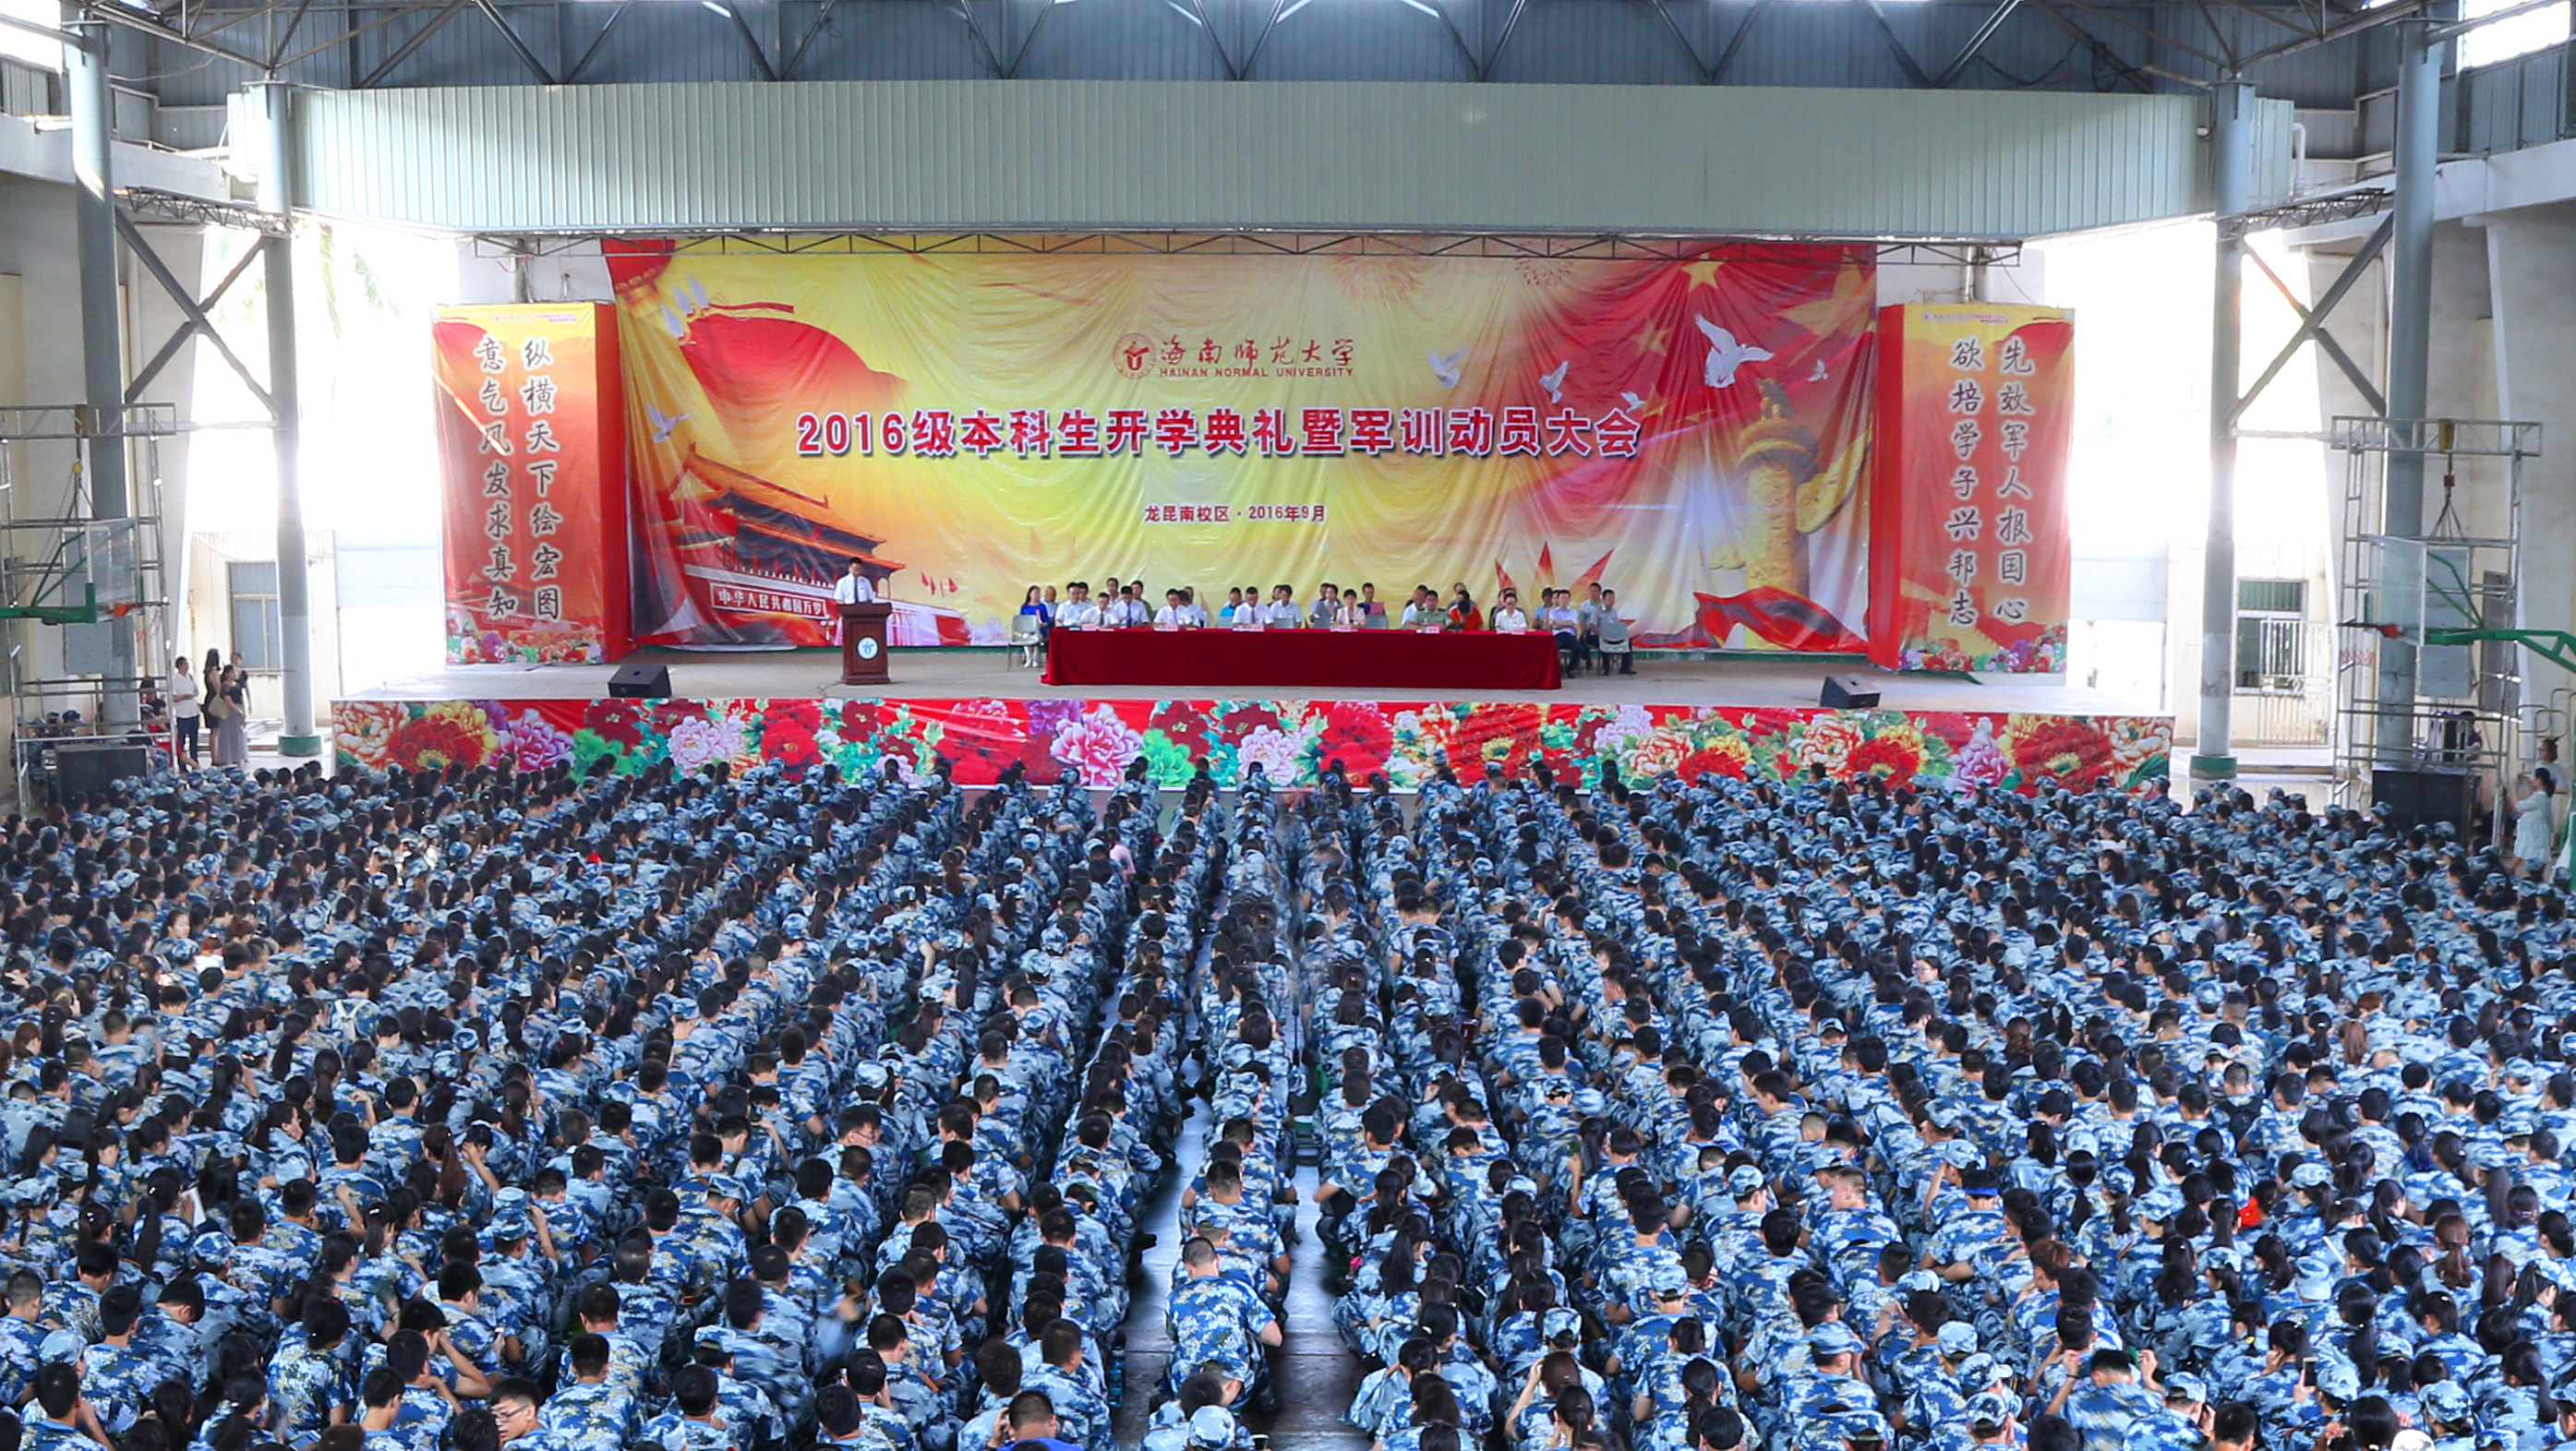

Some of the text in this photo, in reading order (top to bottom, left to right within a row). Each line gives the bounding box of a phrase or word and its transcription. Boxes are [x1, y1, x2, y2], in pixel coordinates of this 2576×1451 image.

[475, 338, 516, 618] 意气风发求真知
[522, 339, 561, 619] 纵横天下绘宏图
[797, 408, 1641, 457] 2016级本科生开学典礼暨军训动员大会
[1160, 367, 1354, 377] HAINAN NORMAL UNIVERSITY
[1161, 334, 1354, 367] 海南师范大学
[1947, 340, 1984, 626] 欲培学子兴邦志
[1996, 340, 2033, 620] 先效军人报国心
